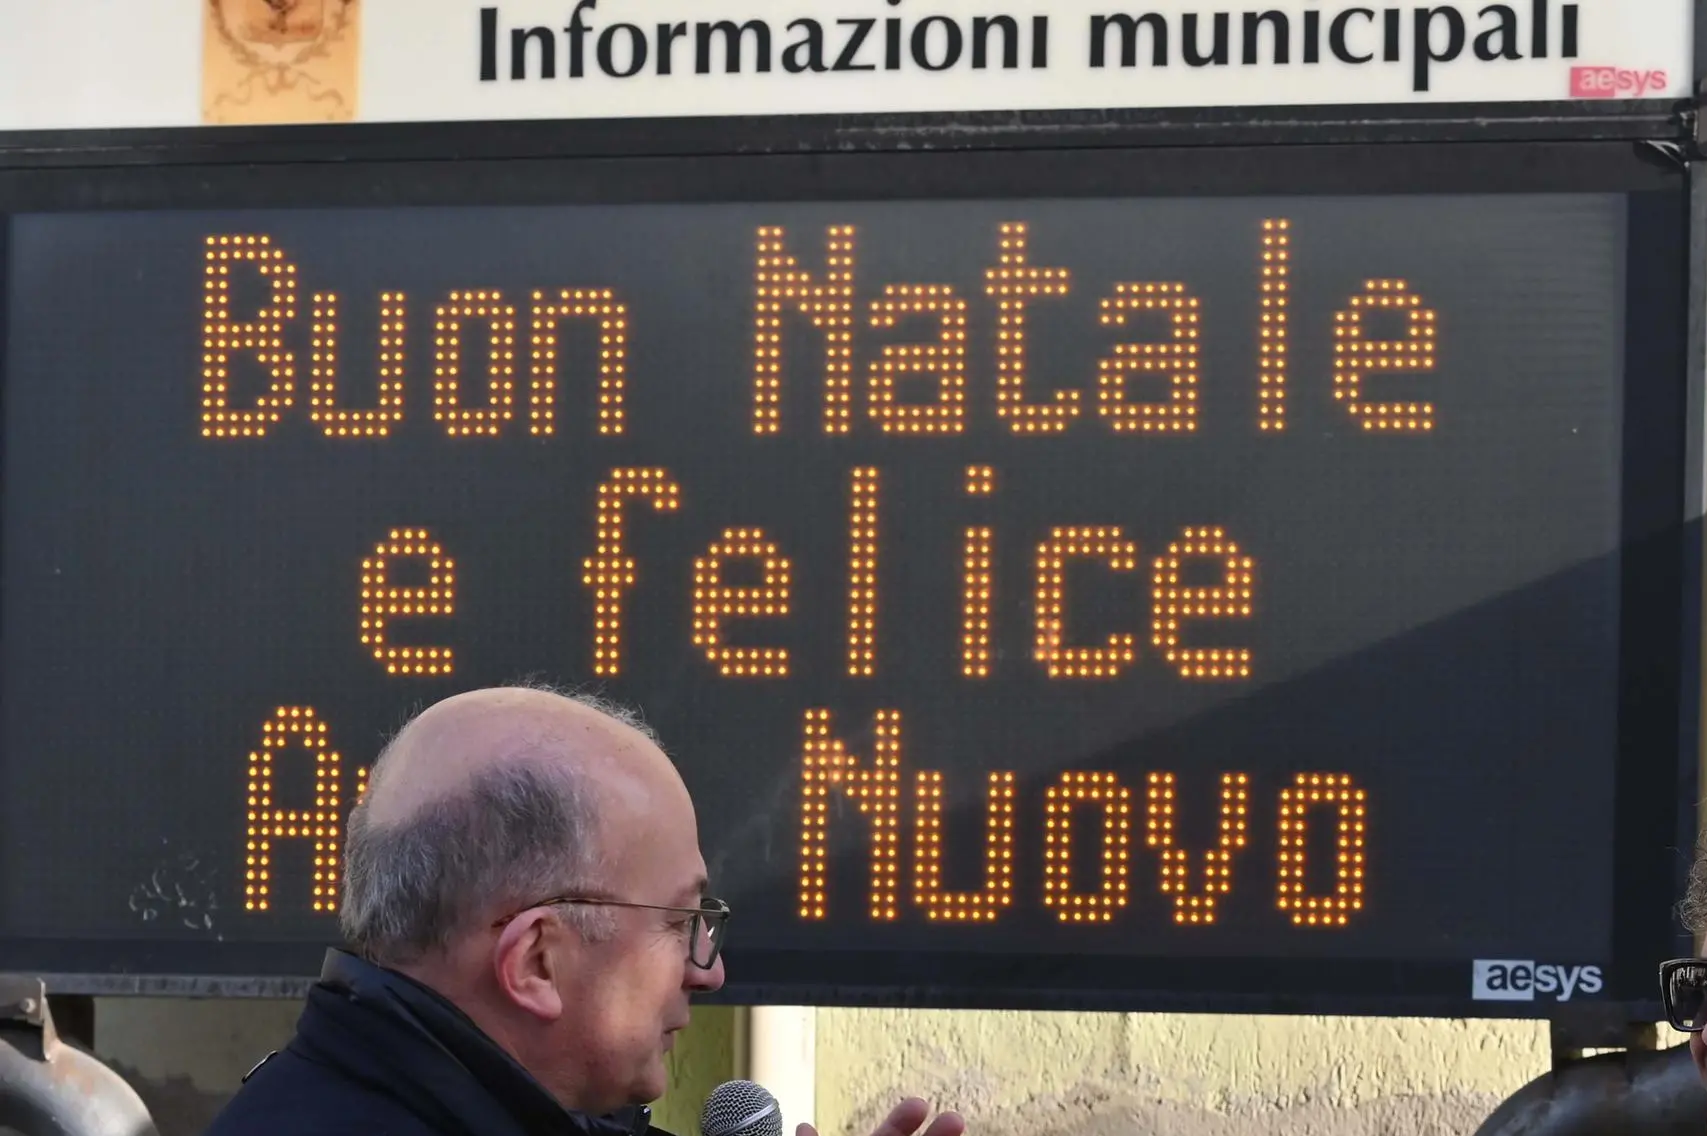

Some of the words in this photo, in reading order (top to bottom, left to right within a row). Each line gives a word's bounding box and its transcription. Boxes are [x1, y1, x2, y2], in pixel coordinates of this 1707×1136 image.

[479, 0, 1049, 81] Informazioni
[1088, 0, 1579, 92] municipali
[1579, 67, 1667, 97] aesys
[201, 234, 627, 438] Buon
[752, 218, 1436, 434] Natale
[360, 527, 455, 675] e
[582, 465, 1254, 678] felice
[799, 708, 1366, 925] Nuovo
[1486, 964, 1603, 1002] aesys
